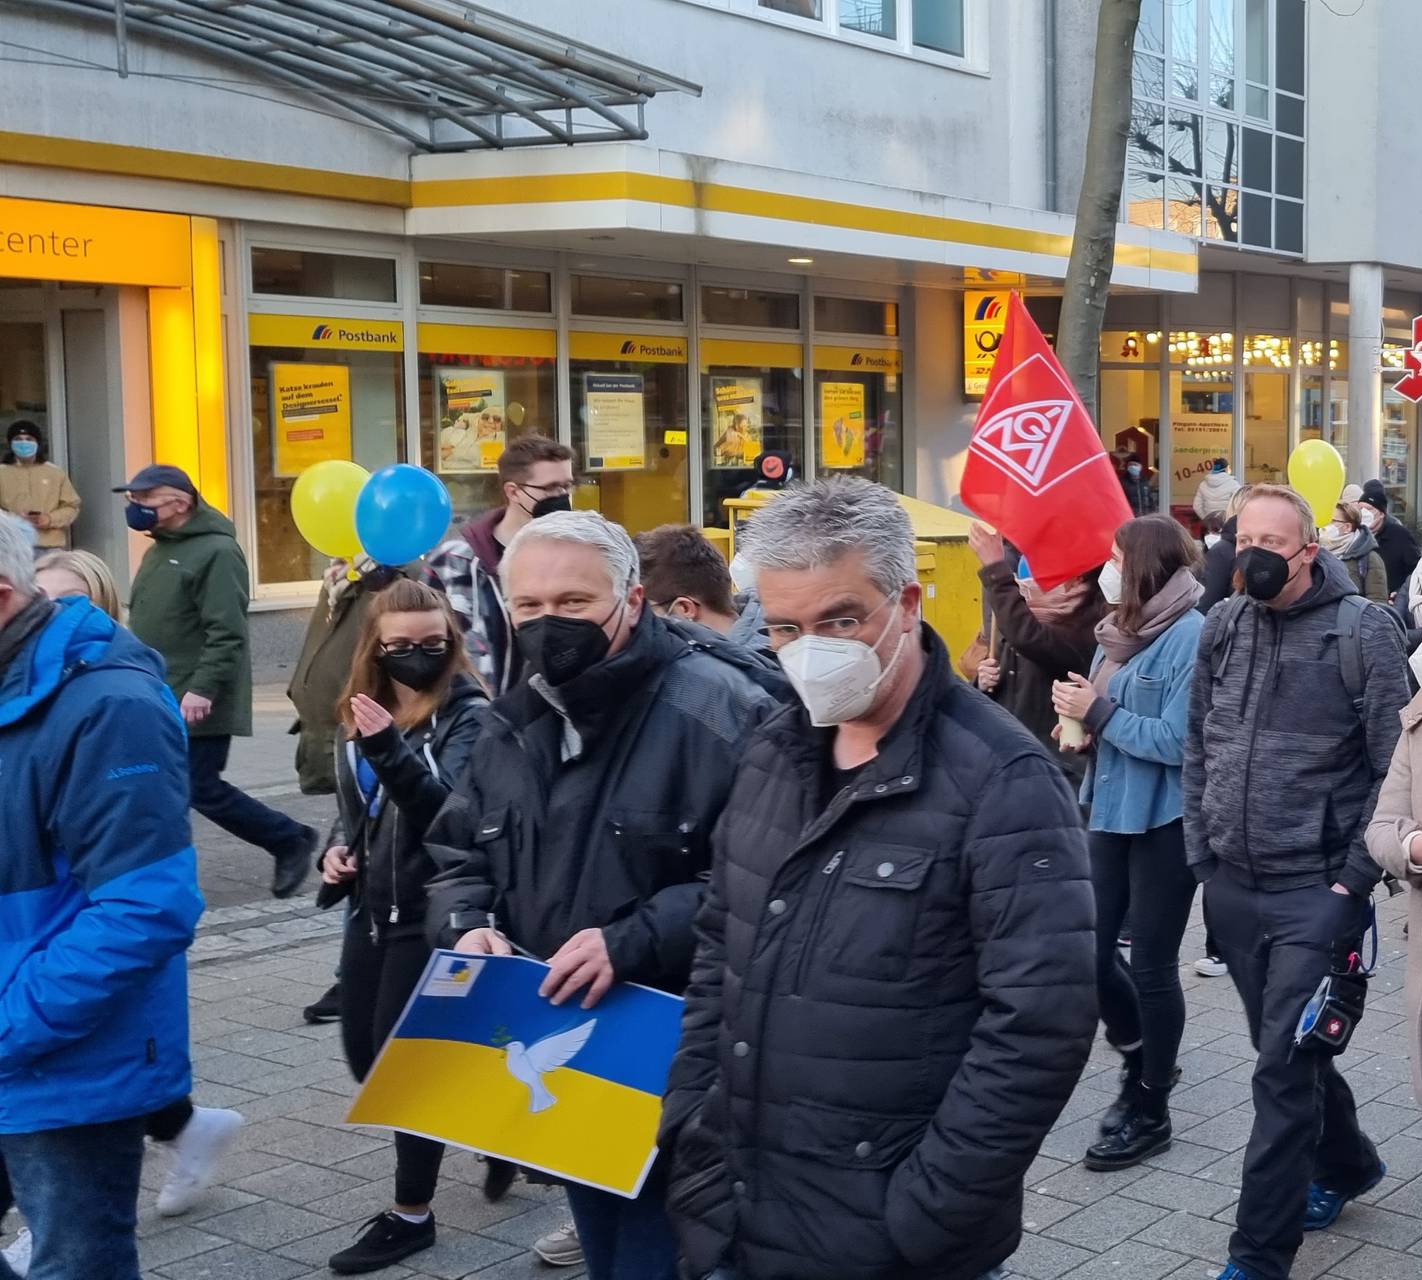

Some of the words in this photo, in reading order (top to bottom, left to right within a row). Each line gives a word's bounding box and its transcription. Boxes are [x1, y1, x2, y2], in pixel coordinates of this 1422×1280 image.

[0, 231, 93, 258] enter
[338, 329, 397, 343] Postbank
[639, 344, 683, 357] Postbank
